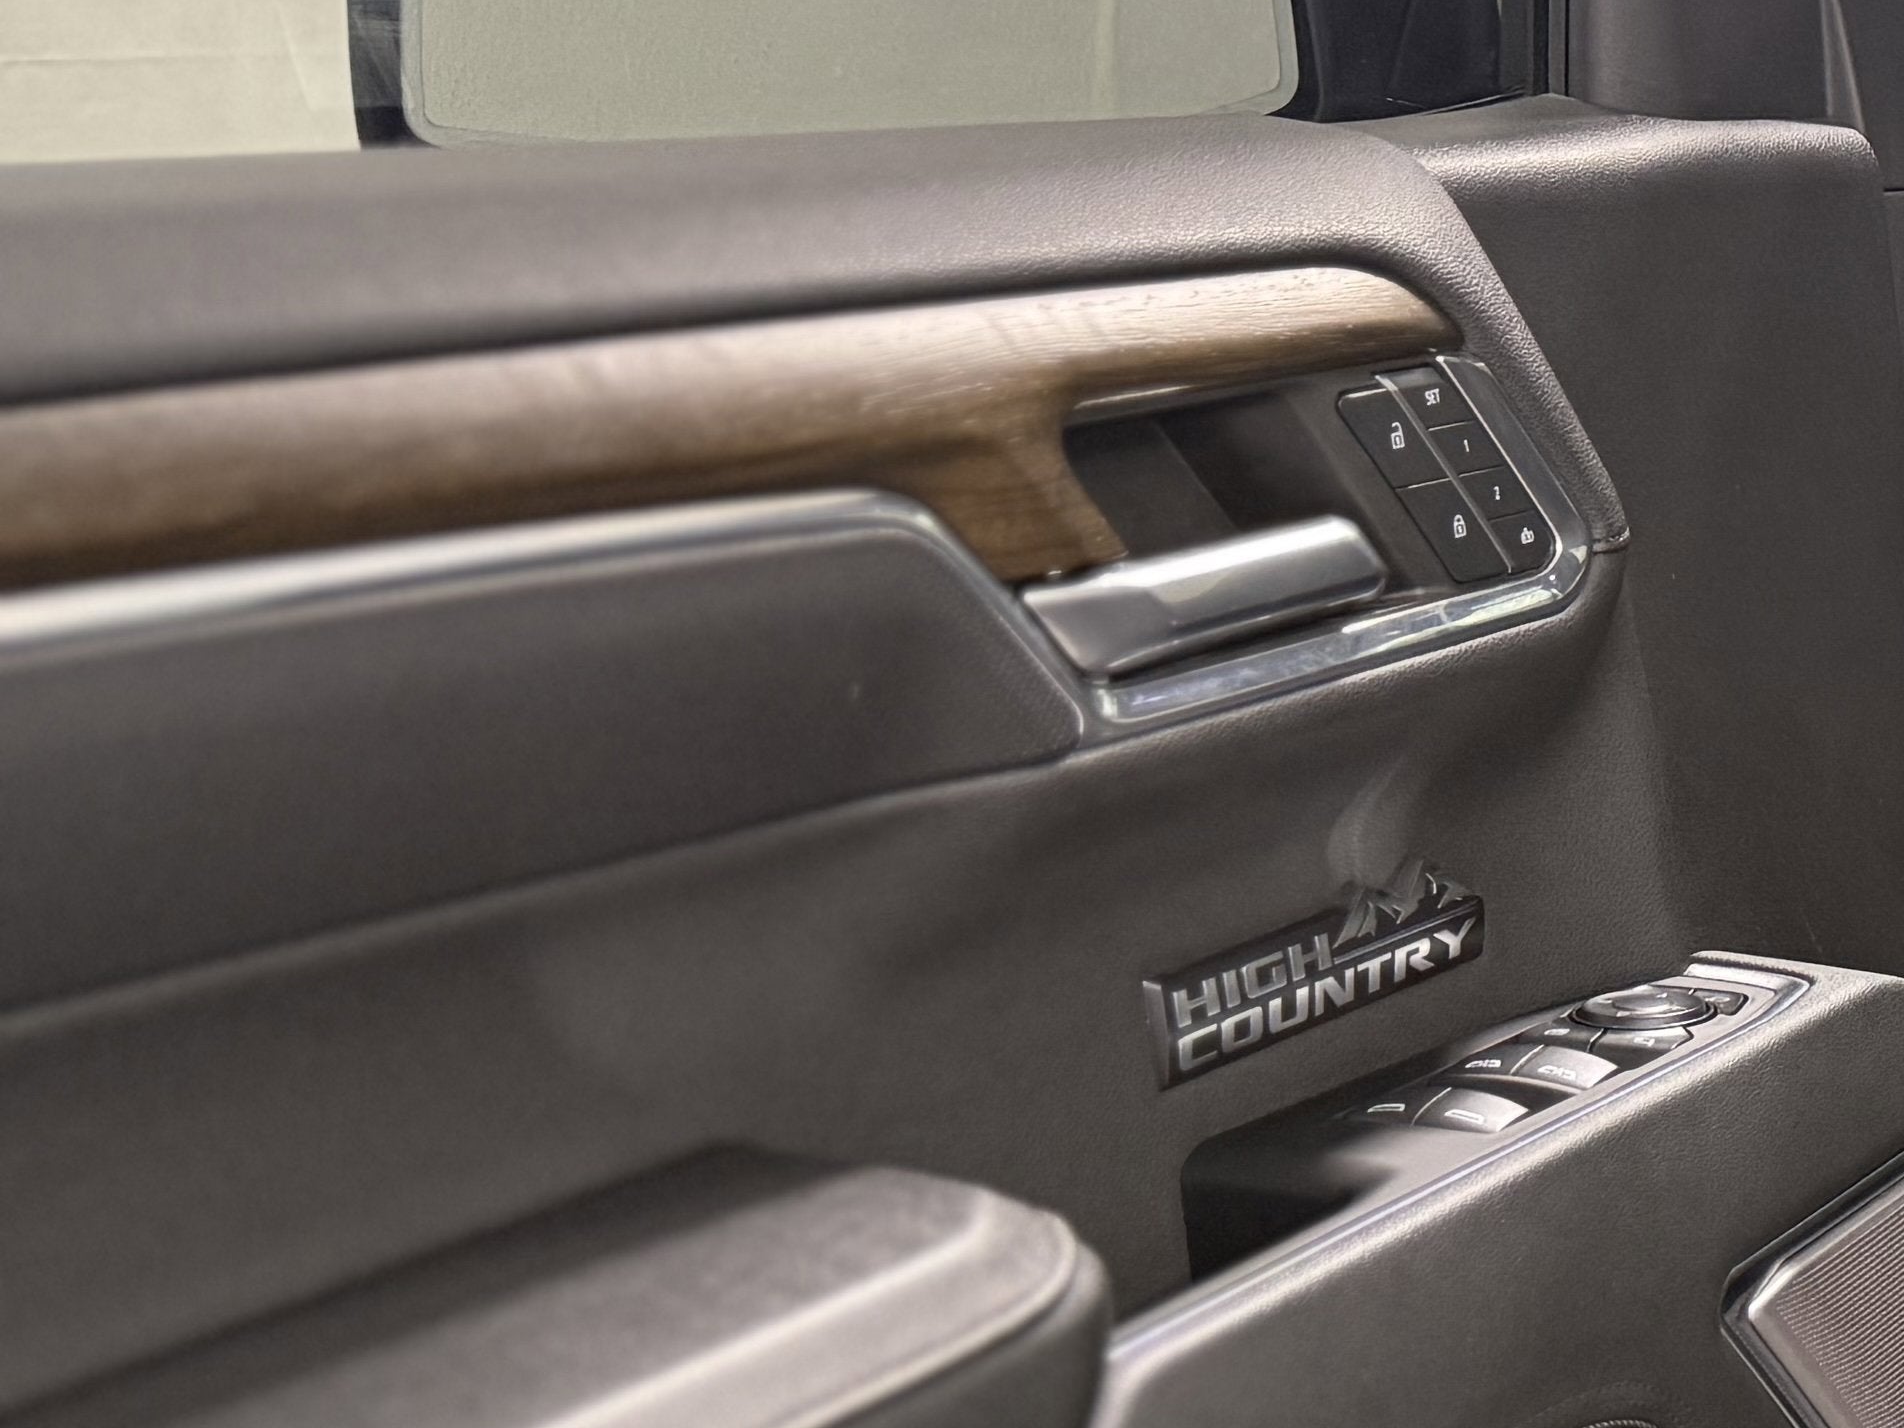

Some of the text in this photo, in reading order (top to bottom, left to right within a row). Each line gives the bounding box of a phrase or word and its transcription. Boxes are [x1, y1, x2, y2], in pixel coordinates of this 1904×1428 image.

[1424, 387, 1441, 406] SET
[1492, 485, 1501, 501] 2
[1172, 932, 1333, 1029] HIGH
[1177, 917, 1477, 1071] COUNTRY
